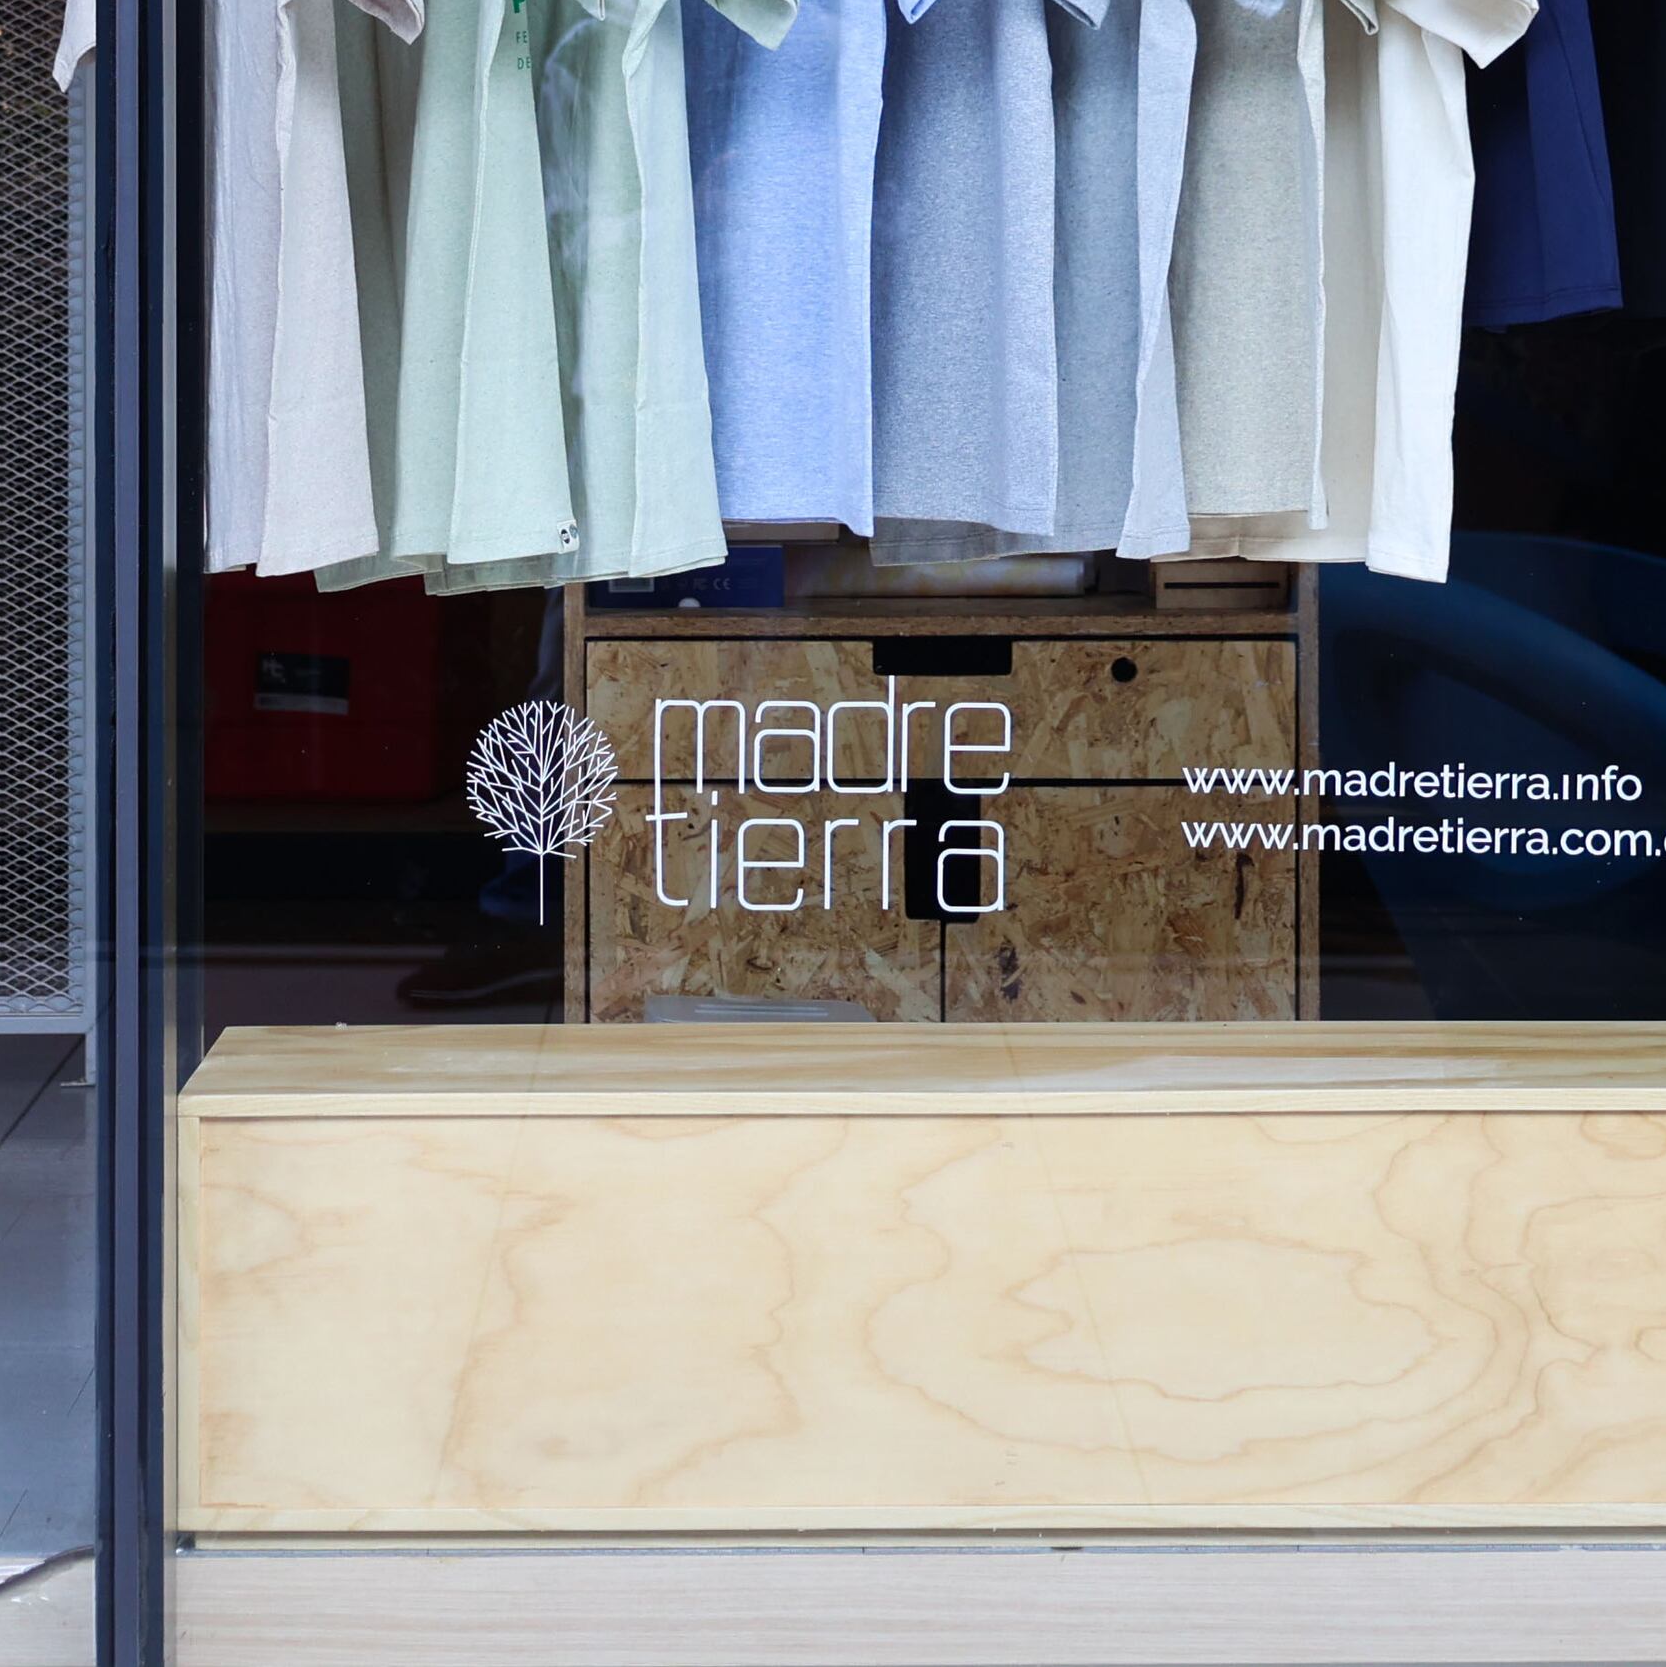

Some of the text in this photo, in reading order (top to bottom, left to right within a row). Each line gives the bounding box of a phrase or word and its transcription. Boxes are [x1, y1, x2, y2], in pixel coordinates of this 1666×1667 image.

[654, 674, 1012, 795] madre
[1182, 761, 1642, 801] www.madretierra.info
[645, 790, 1005, 913] tierra
